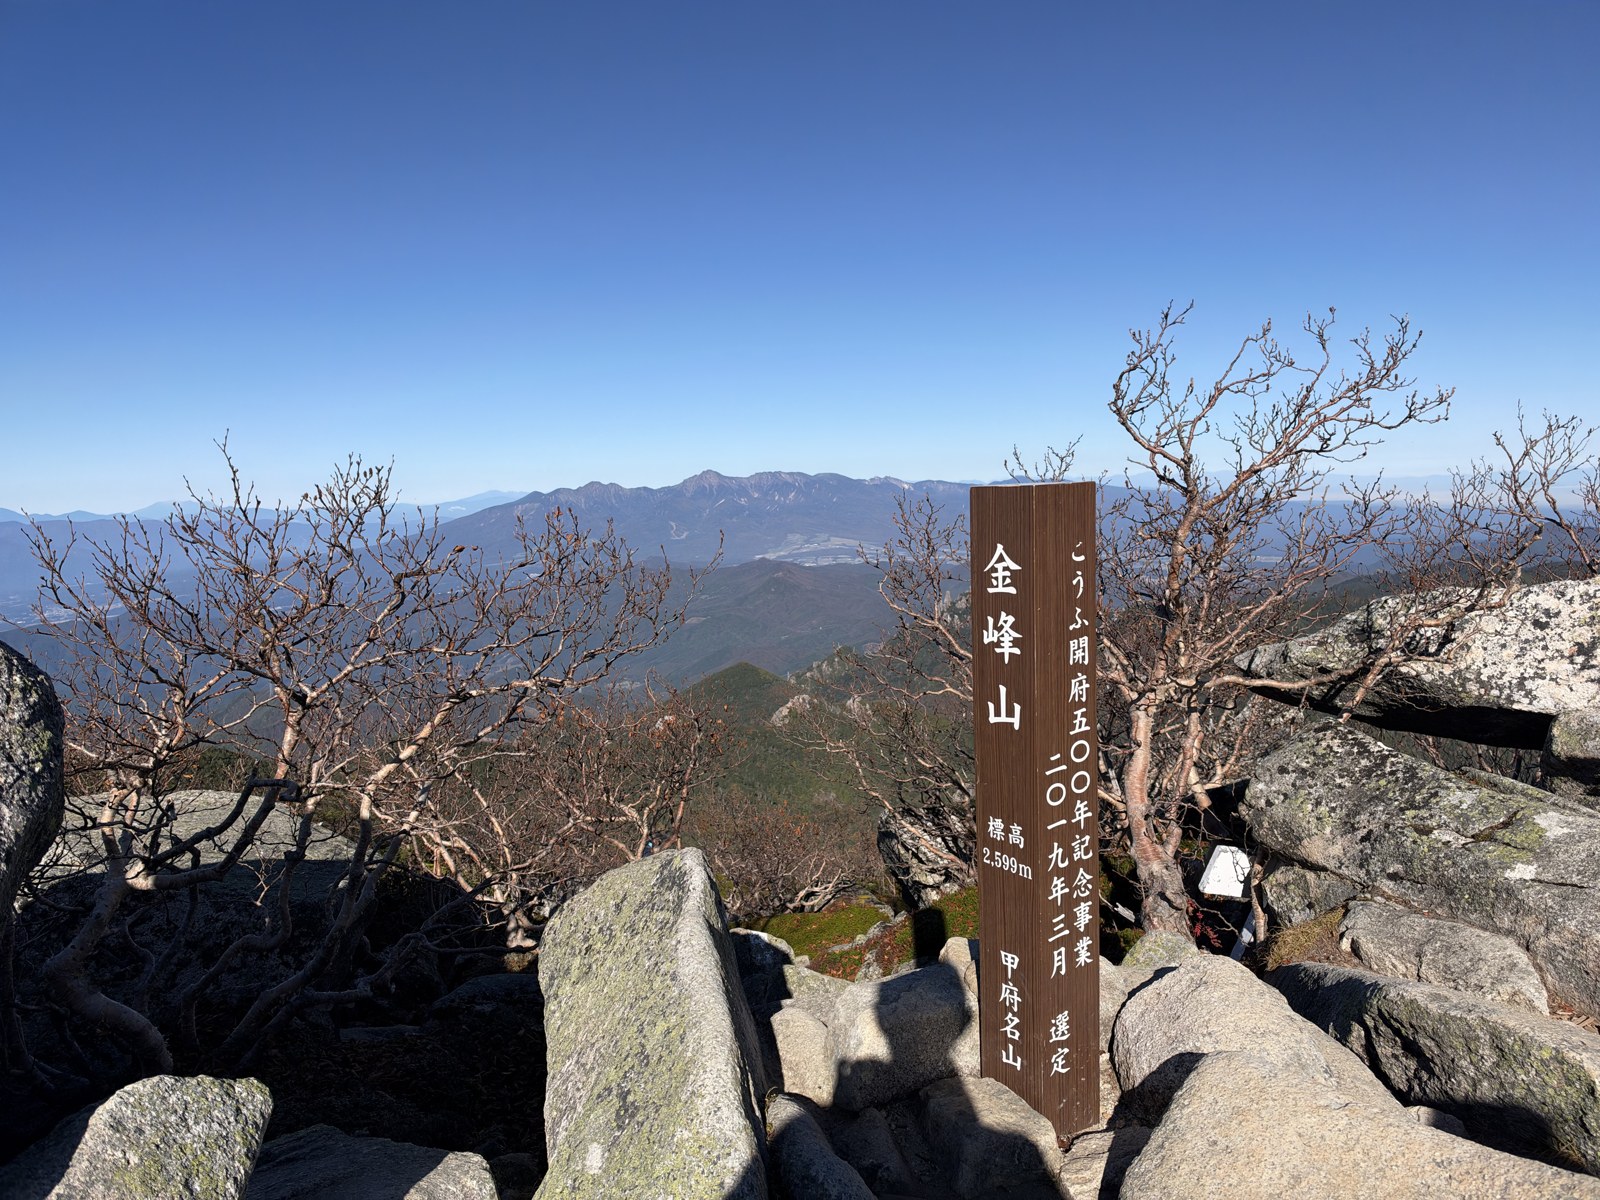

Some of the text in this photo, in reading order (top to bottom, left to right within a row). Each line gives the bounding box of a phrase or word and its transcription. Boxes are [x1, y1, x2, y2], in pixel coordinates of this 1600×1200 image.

[983, 543, 1023, 731] 金峰山
[982, 847, 1033, 880] 2,599m
[987, 815, 1025, 849] 標高
[1045, 753, 1071, 1077] 二〇一九年三月 選定
[999, 951, 1022, 1072] 甲府名山
